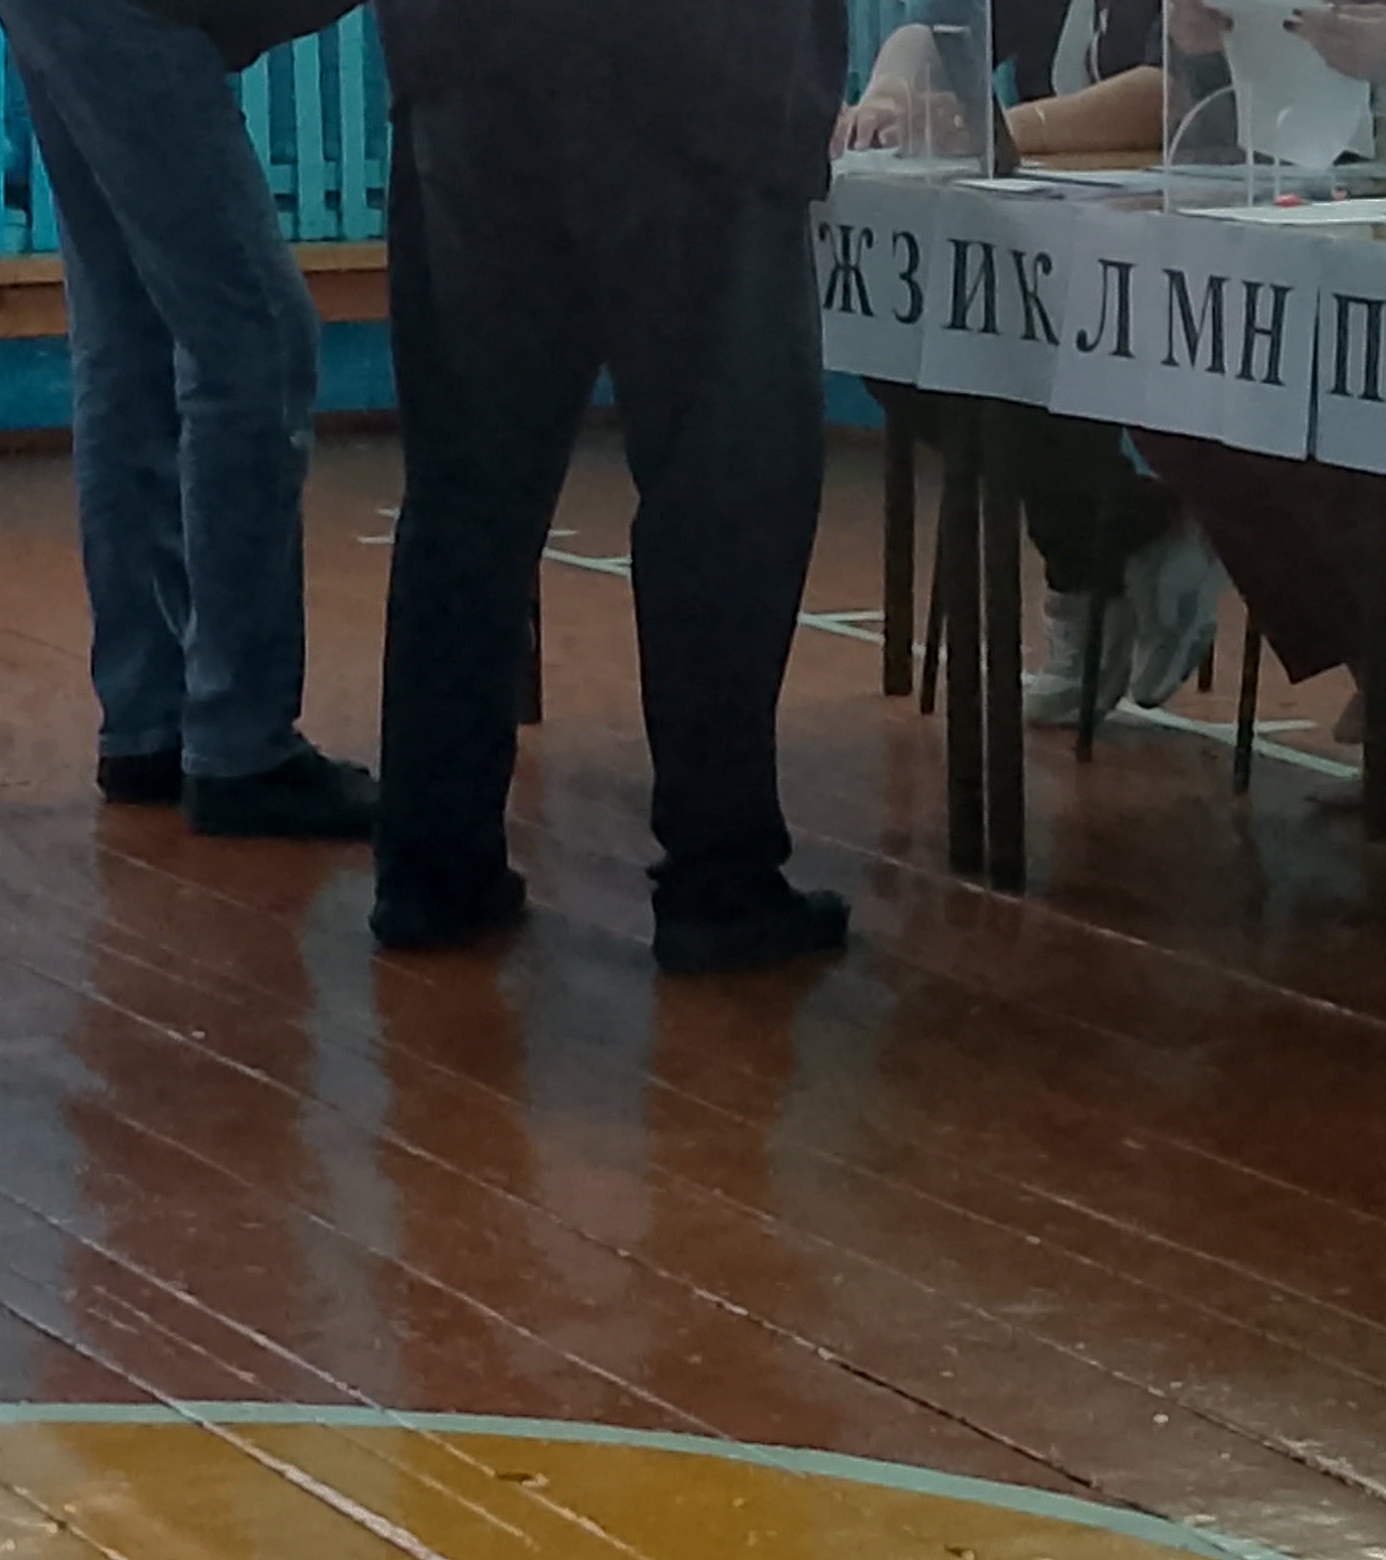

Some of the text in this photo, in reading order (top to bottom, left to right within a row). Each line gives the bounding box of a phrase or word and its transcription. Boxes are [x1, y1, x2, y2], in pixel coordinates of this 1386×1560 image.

[819, 222, 876, 317] Ж
[892, 231, 924, 325] З
[942, 238, 1001, 335] И
[1008, 249, 1060, 346] К
[1076, 258, 1137, 358] Л
[1161, 268, 1230, 375] М
[1236, 279, 1293, 386] Н
